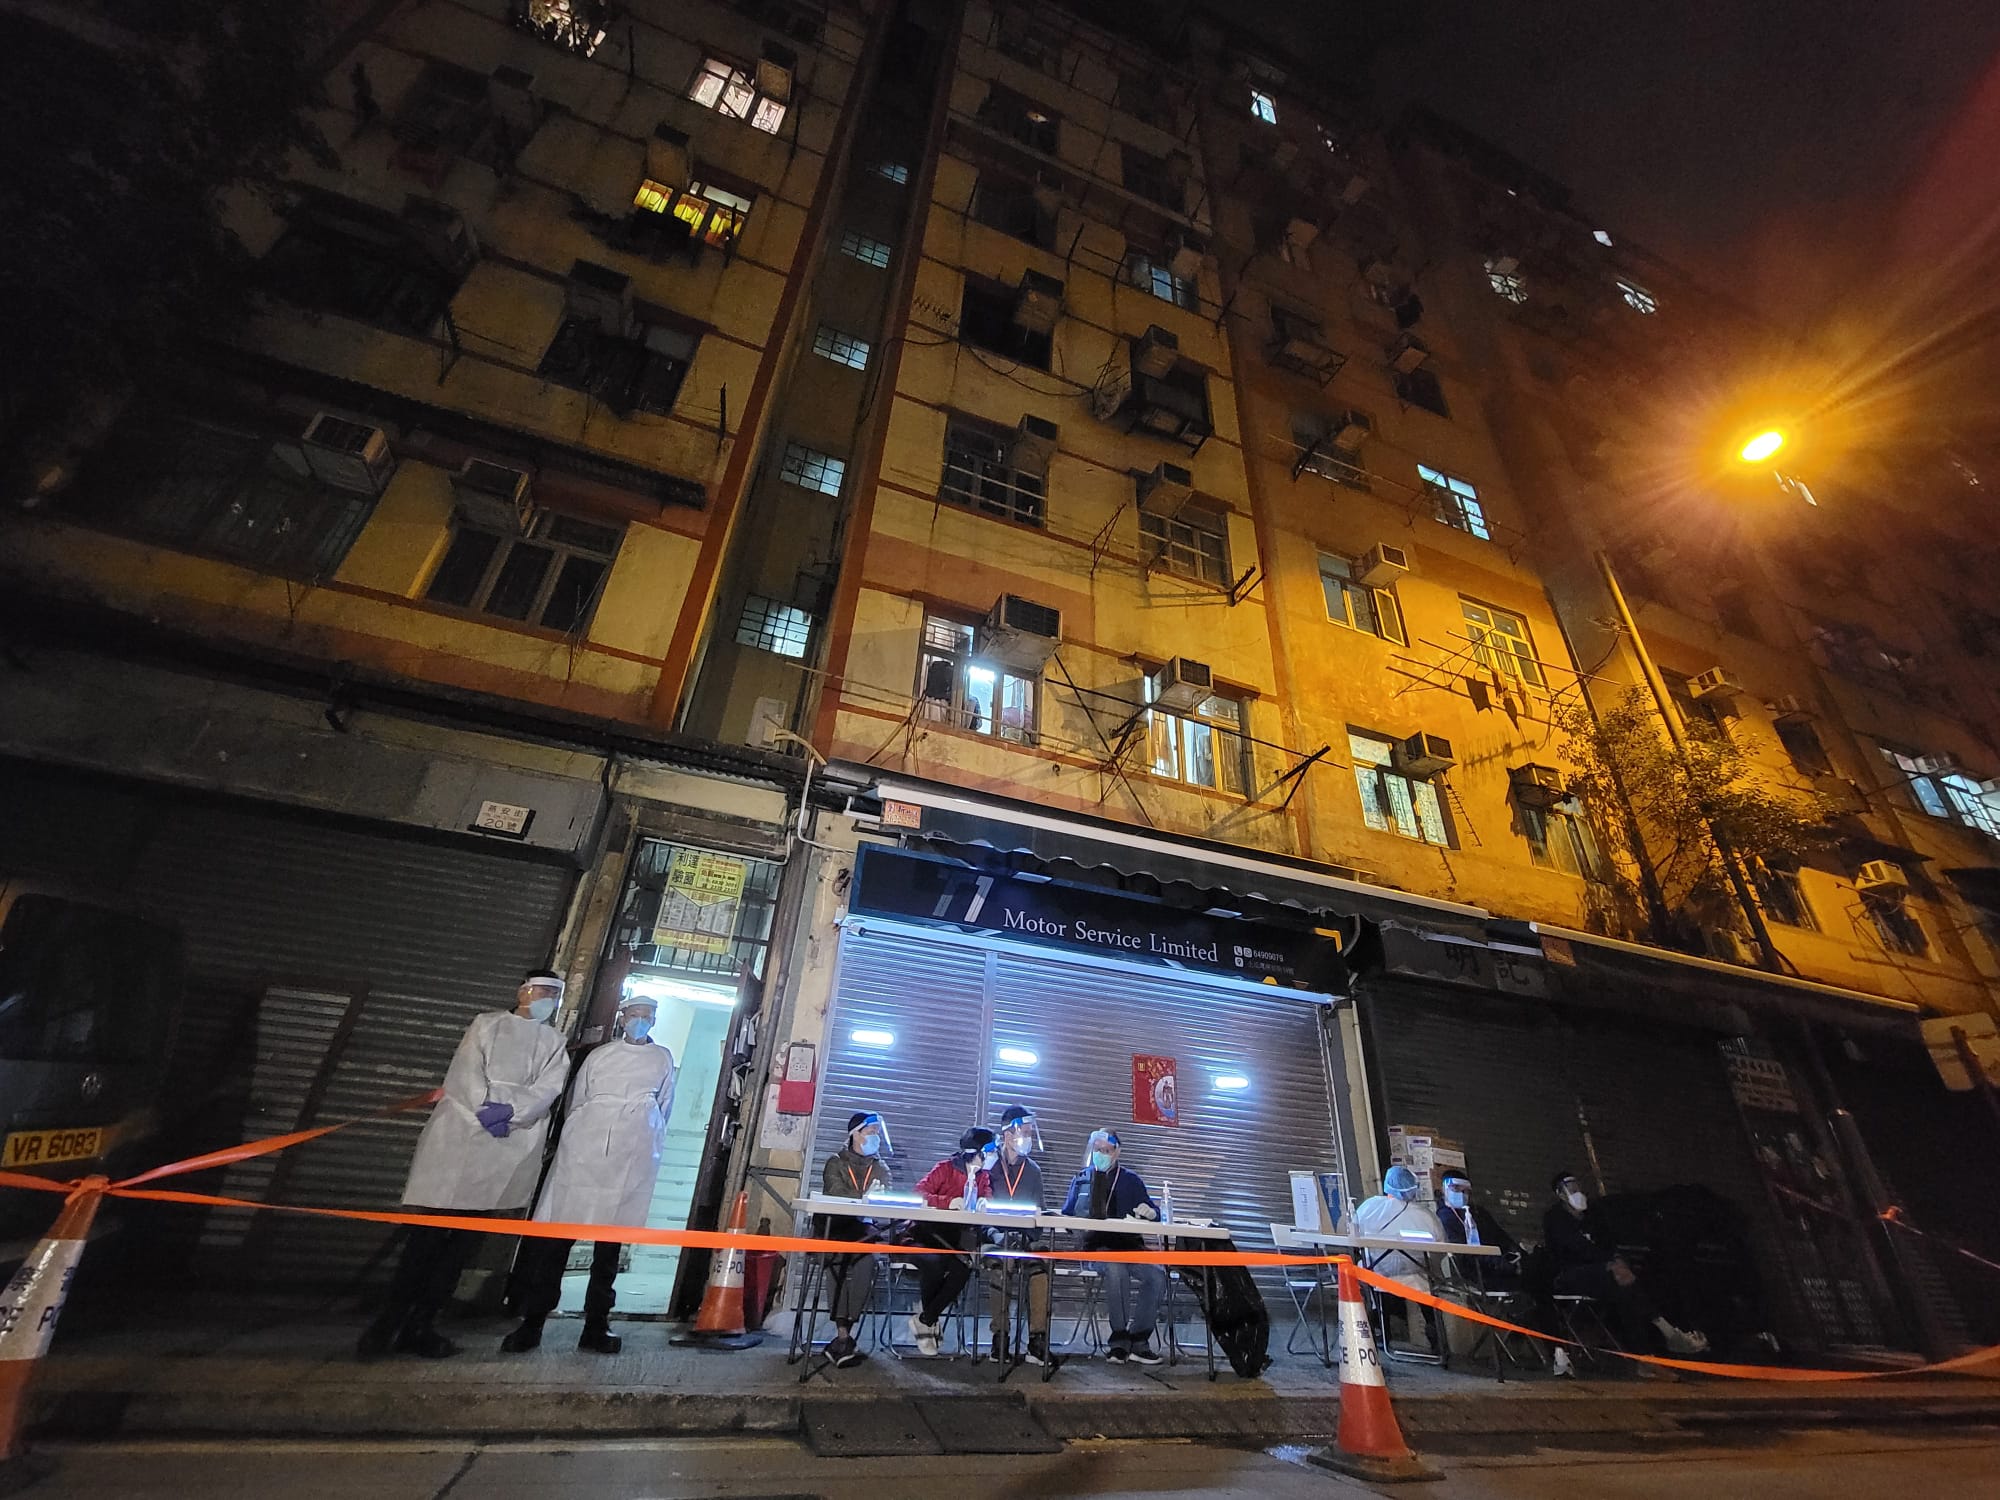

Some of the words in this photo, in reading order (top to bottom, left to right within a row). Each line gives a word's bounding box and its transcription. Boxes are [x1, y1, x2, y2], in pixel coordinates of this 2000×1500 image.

[1003, 907, 1067, 937] Motor
[1075, 920, 1141, 949] Service
[1149, 932, 1219, 962] Limited
[13, 1135, 43, 1161] VR
[47, 1131, 97, 1158] 6083
[1358, 1348, 1381, 1367] PO
